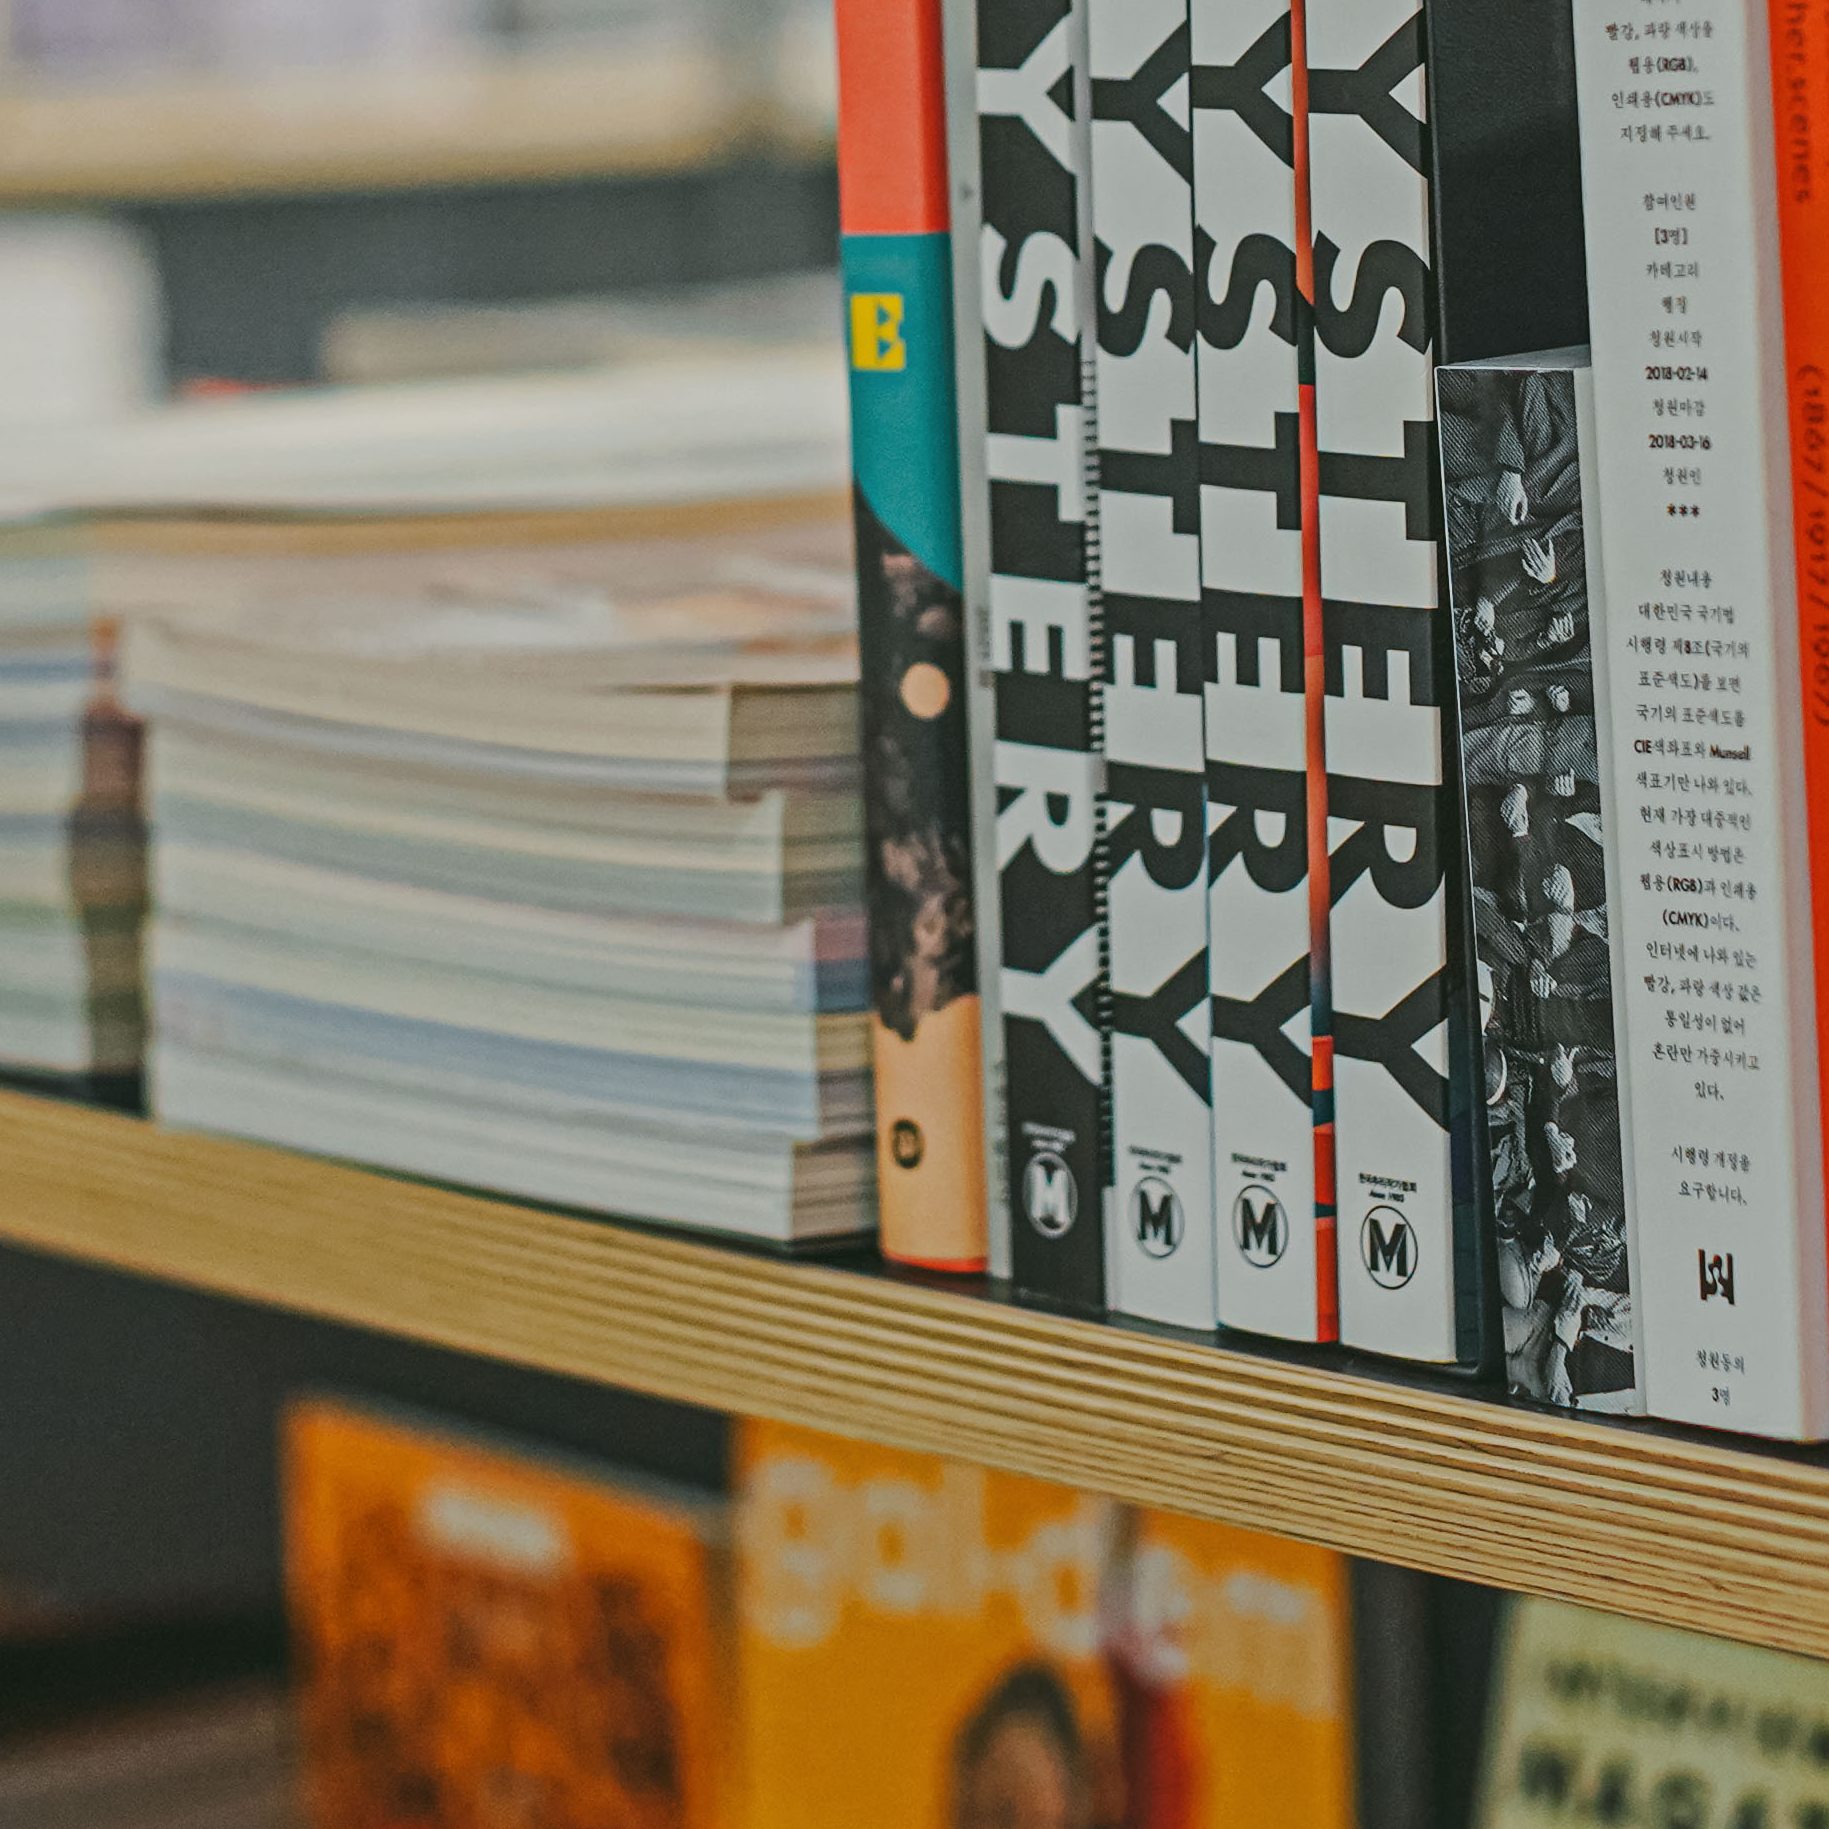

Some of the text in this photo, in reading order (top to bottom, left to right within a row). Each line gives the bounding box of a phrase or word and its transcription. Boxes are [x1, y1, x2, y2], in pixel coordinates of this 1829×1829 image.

[1643, 21, 1671, 40] 파랑
[1675, 20, 1714, 40] 색상을
[1620, 123, 1663, 142] 지정해
[1642, 192, 1697, 212] 참여인원
[1645, 262, 1701, 279] 카테고리
[1660, 295, 1688, 315] 행정
[1649, 329, 1703, 349] 청원시작
[1644, 365, 1709, 381] 2018-02-14
[1651, 397, 1706, 418] 청원마감
[1647, 433, 1714, 451] 2018-03-16
[1662, 466, 1702, 486] 청원인
[1659, 569, 1713, 589] 청원내용
[1638, 602, 1735, 624] 대한민국 국기법
[1625, 634, 1667, 655] 시행령
[1715, 675, 1741, 694] 보면
[1635, 704, 1746, 729] 국기의 표준색도를
[1708, 744, 1752, 762] Munsell
[1635, 771, 1691, 794] 색표기만
[1693, 774, 1720, 794] 나와
[1638, 805, 1752, 832] 현재 가장 대중적인
[1707, 844, 1746, 865] 방법은
[1719, 879, 1758, 902] 인쇄용
[1645, 941, 1757, 970] 인터넷에 나와 있는
[1678, 977, 1707, 999] 파랑
[1708, 980, 1735, 1001] 색상
[1737, 983, 1763, 1005] 값은
[1663, 1010, 1746, 1037] 통일성이 없어
[1651, 1041, 1761, 1071] 혼란만 가중시키고
[1693, 1079, 1725, 1102] 있다.
[1671, 1144, 1752, 1174] 시행령 개정을
[1695, 1348, 1746, 1375] 청원동의
[1710, 1386, 1731, 1407] 3명
